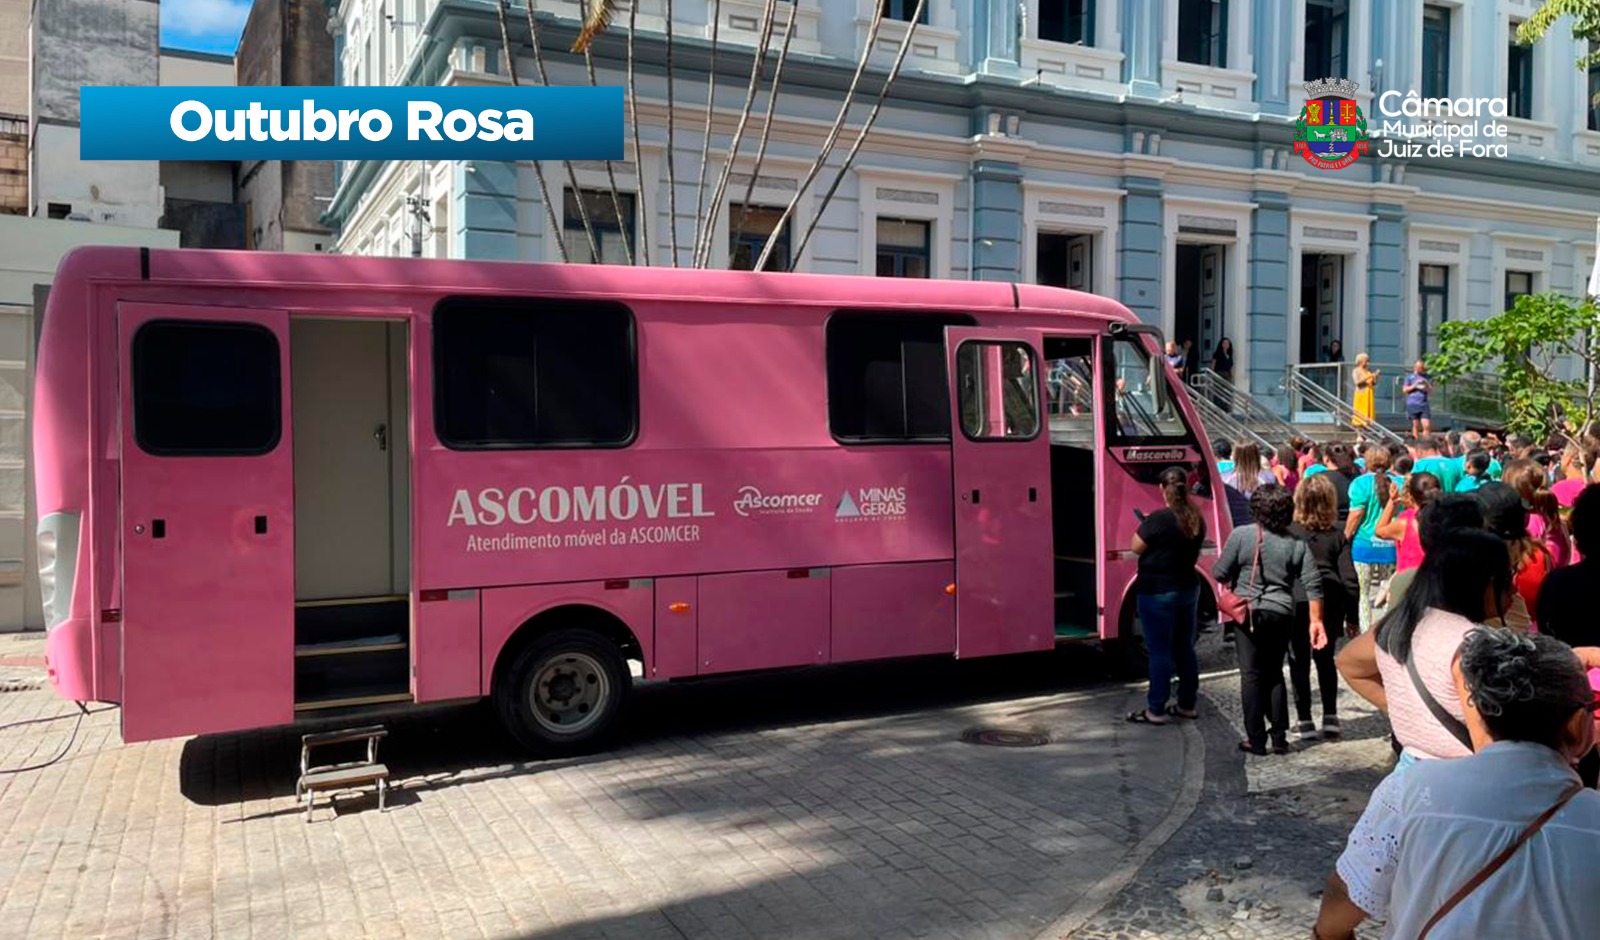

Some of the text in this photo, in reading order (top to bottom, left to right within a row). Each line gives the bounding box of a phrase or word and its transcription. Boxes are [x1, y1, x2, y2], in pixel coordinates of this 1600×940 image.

[1126, 449, 1184, 461] Mascarello
[447, 475, 715, 527] ASCOMÓVEL
[739, 492, 823, 508] Ascomcer
[859, 487, 906, 503] MINAS
[860, 501, 906, 516] GERAIS
[466, 524, 700, 552] Atendimento móvel da ASCOMCER
